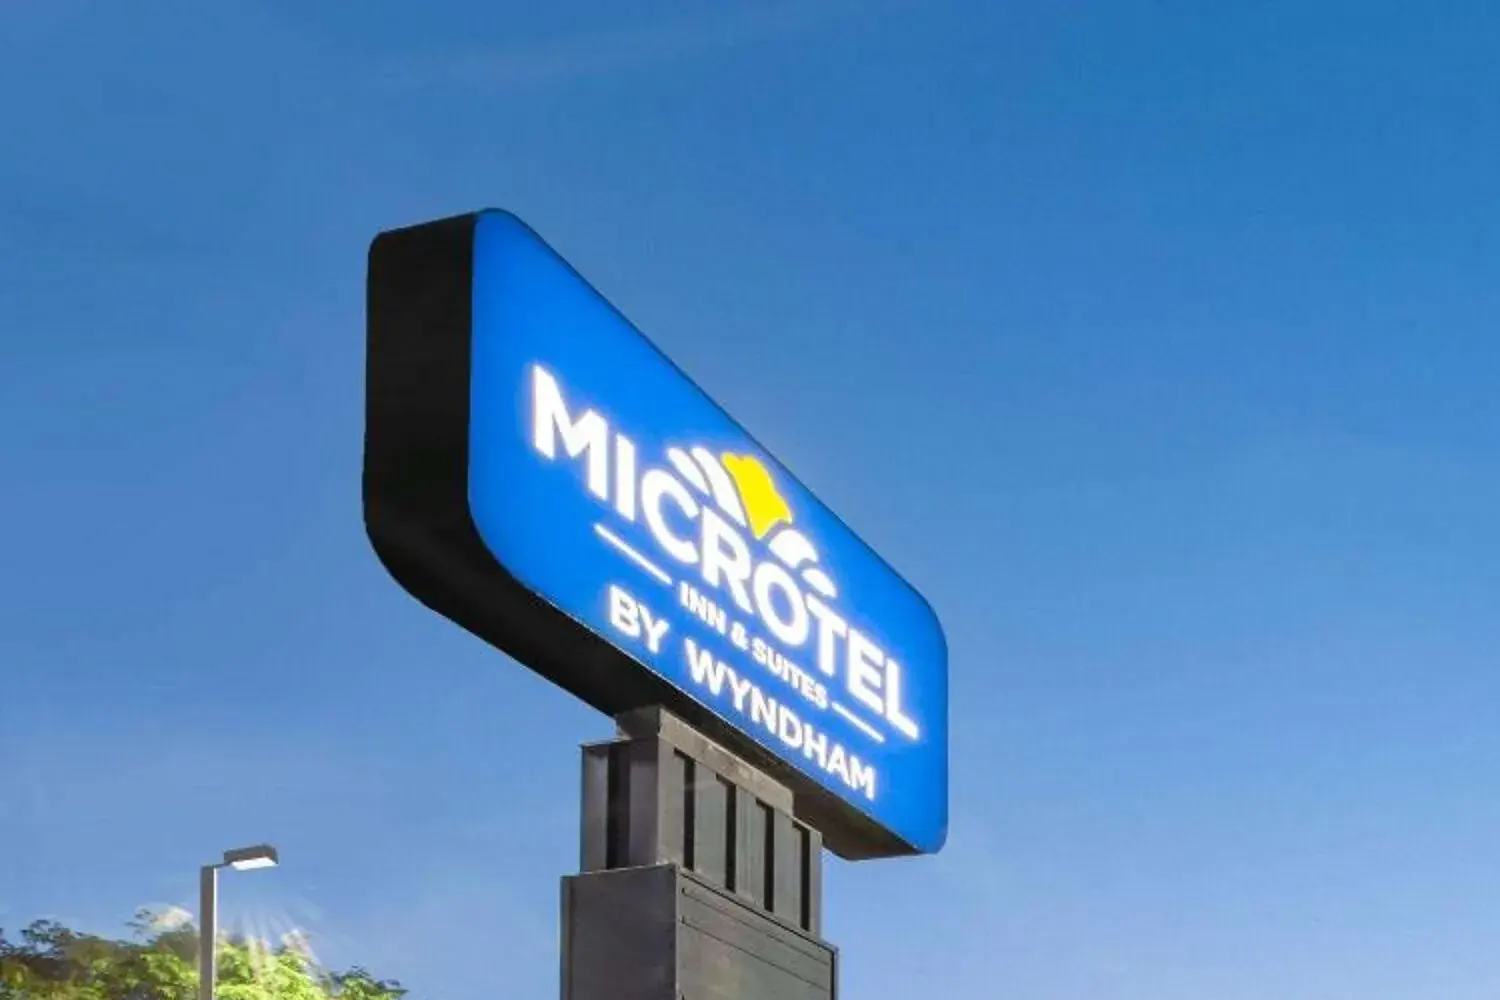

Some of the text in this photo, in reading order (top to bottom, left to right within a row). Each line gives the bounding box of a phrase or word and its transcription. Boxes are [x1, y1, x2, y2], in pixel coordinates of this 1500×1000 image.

[533, 364, 919, 741] MICROTEL
[679, 582, 829, 710] INN & SUITES
[609, 584, 877, 802] BY WYNDHAM
